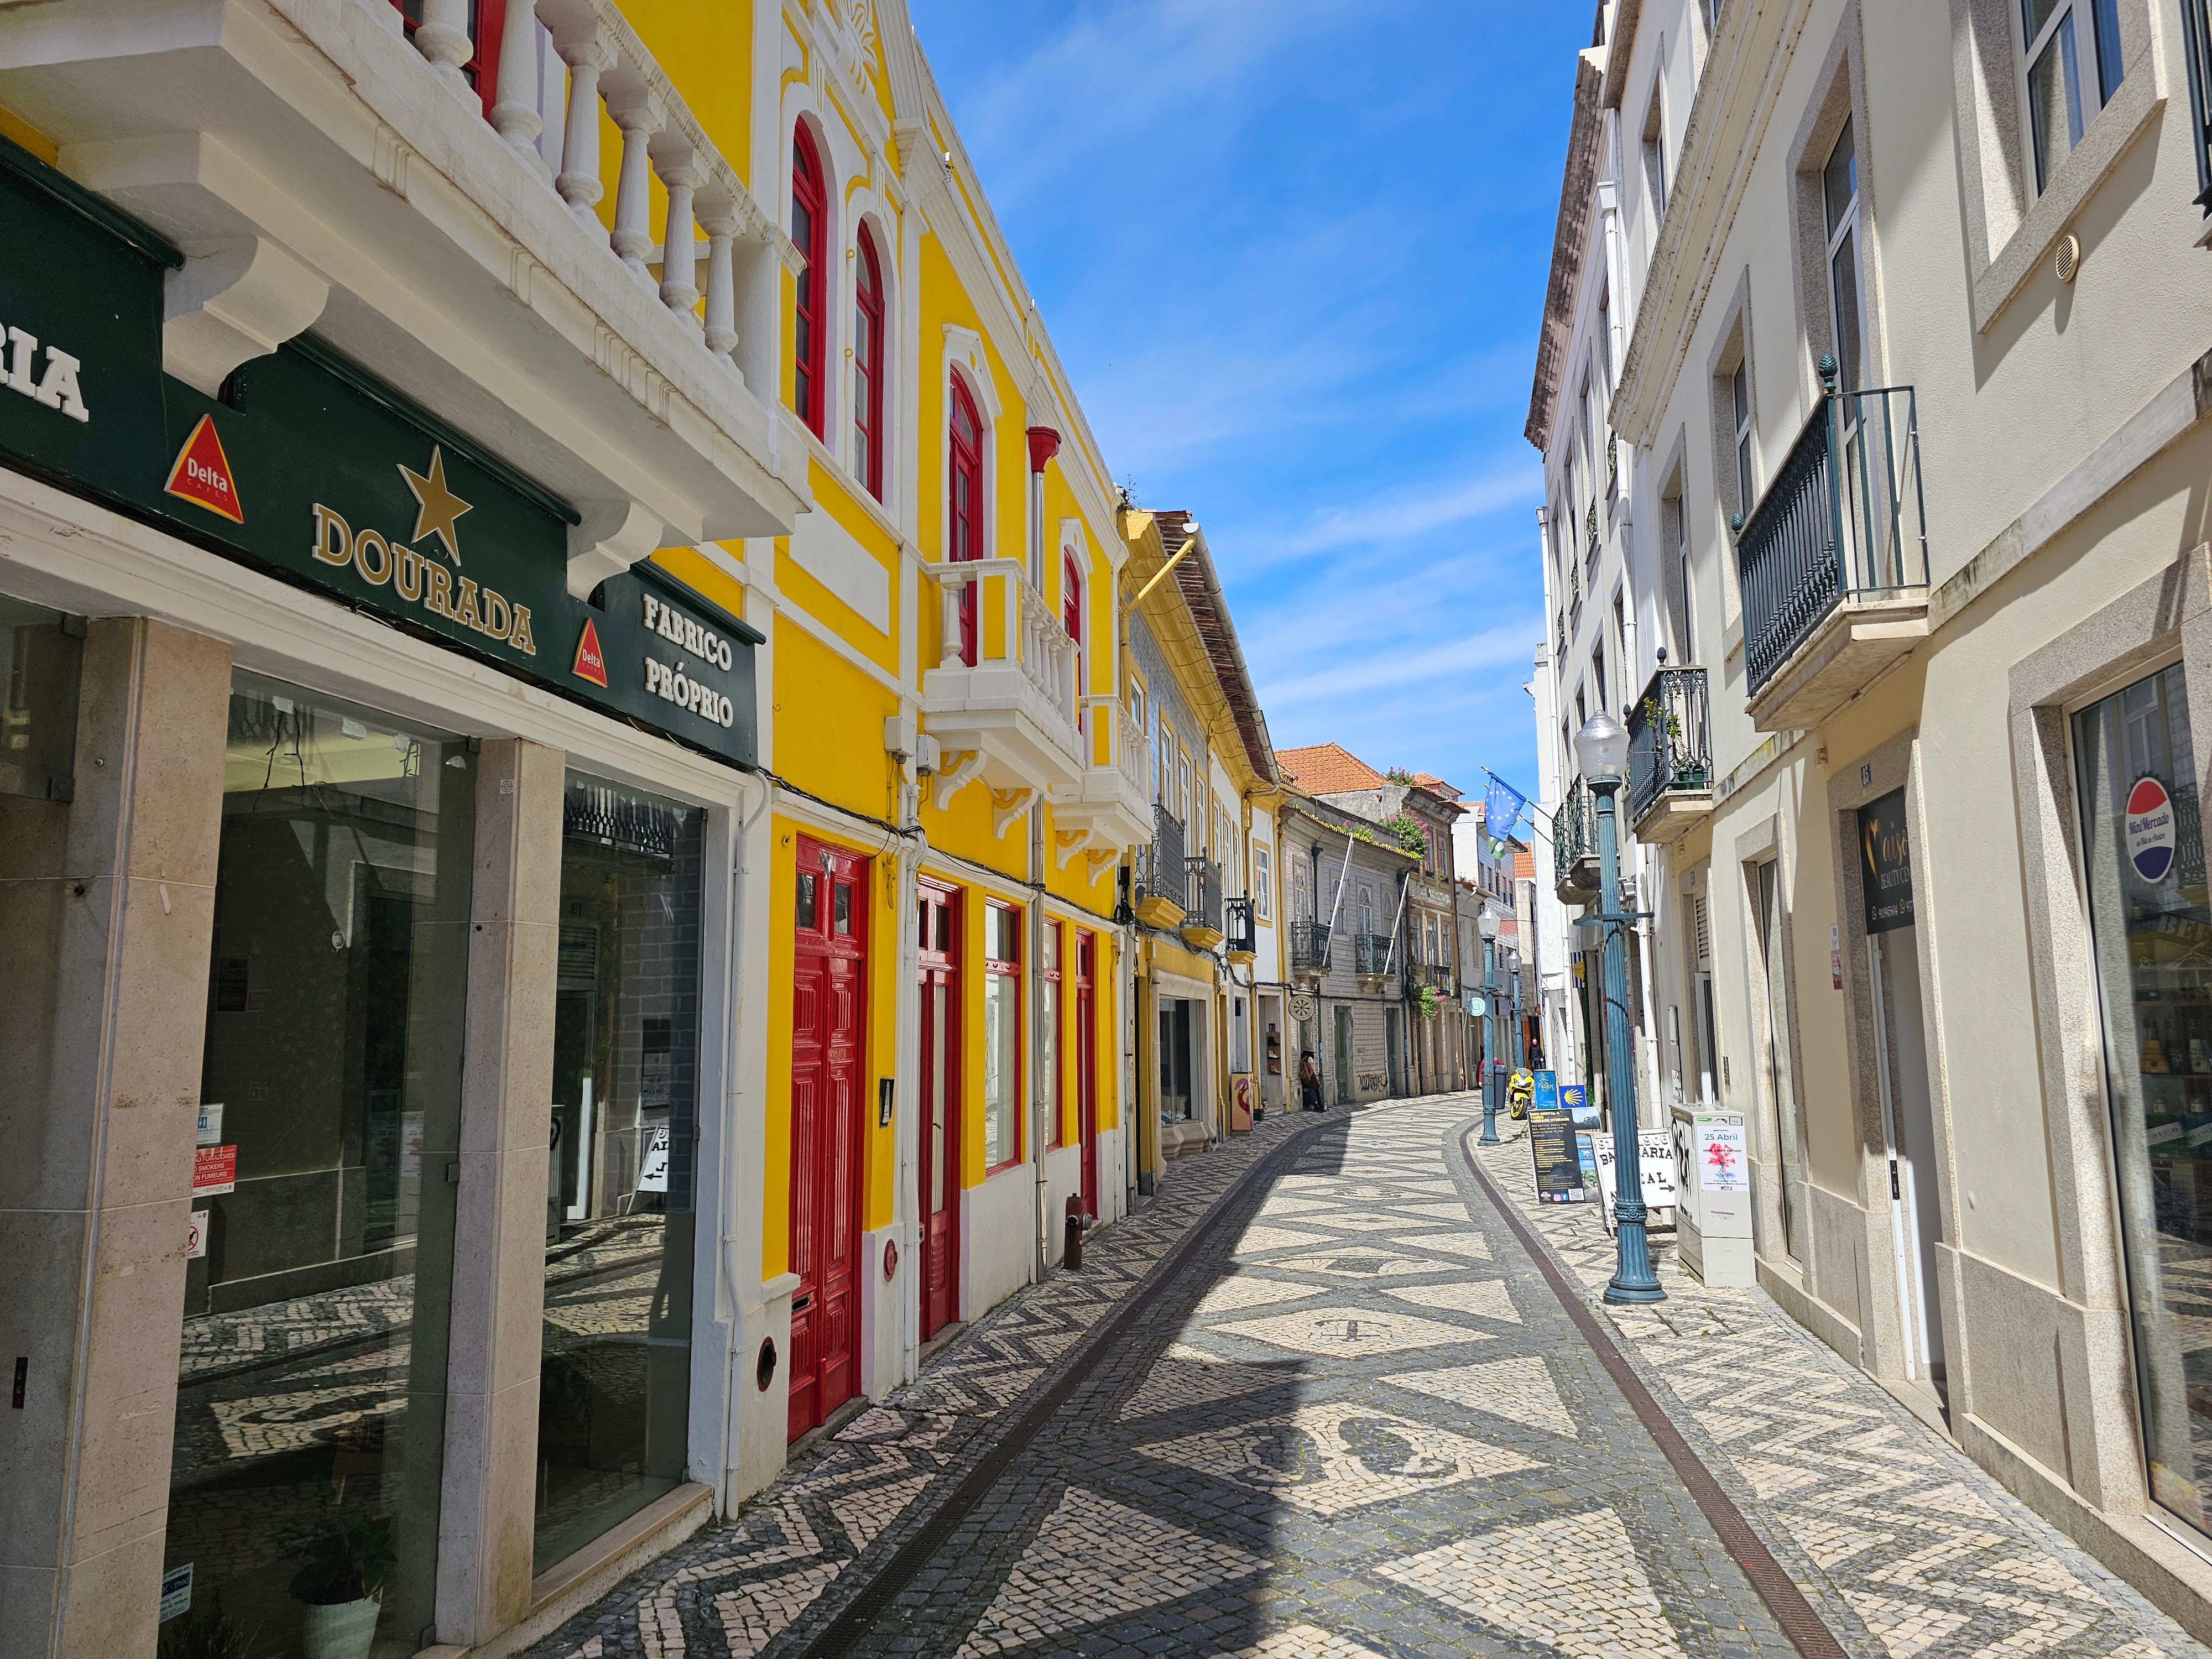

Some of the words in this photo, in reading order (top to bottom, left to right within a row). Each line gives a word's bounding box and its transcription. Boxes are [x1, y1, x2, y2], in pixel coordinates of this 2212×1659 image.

[0, 322, 88, 422] IA
[188, 457, 227, 493] Delta
[312, 502, 536, 655] DOURADA
[643, 593, 732, 671] FABRICO
[582, 648, 601, 669] Delta
[645, 656, 733, 728] PRÓPRIO
[1880, 868, 1900, 889] BEAUTY
[199, 1162, 225, 1172] SMOKERS
[202, 1152, 235, 1162] FUMADORES
[201, 1171, 227, 1180] FUMEURS
